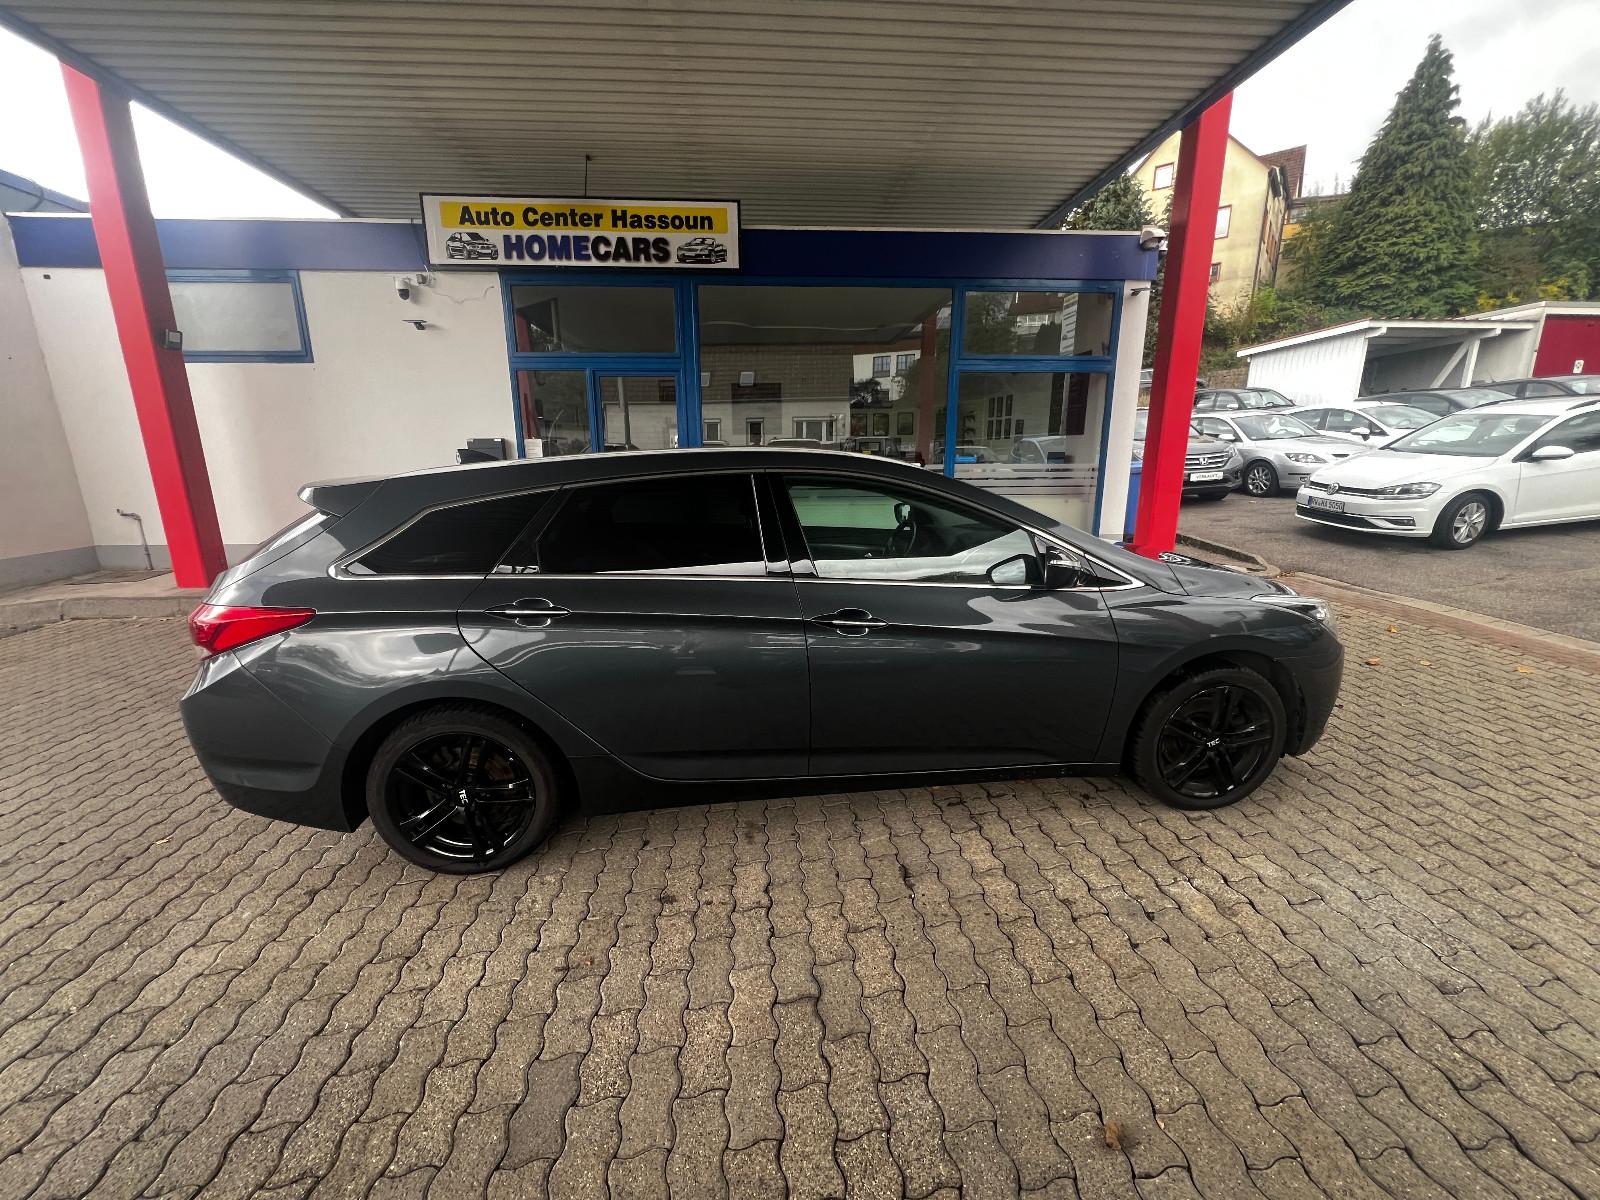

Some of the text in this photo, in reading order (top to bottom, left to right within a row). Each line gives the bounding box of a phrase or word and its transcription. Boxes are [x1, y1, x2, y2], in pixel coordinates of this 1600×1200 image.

[459, 205, 714, 231] Auto Center Hassoun
[502, 234, 671, 263] HOMECARS
